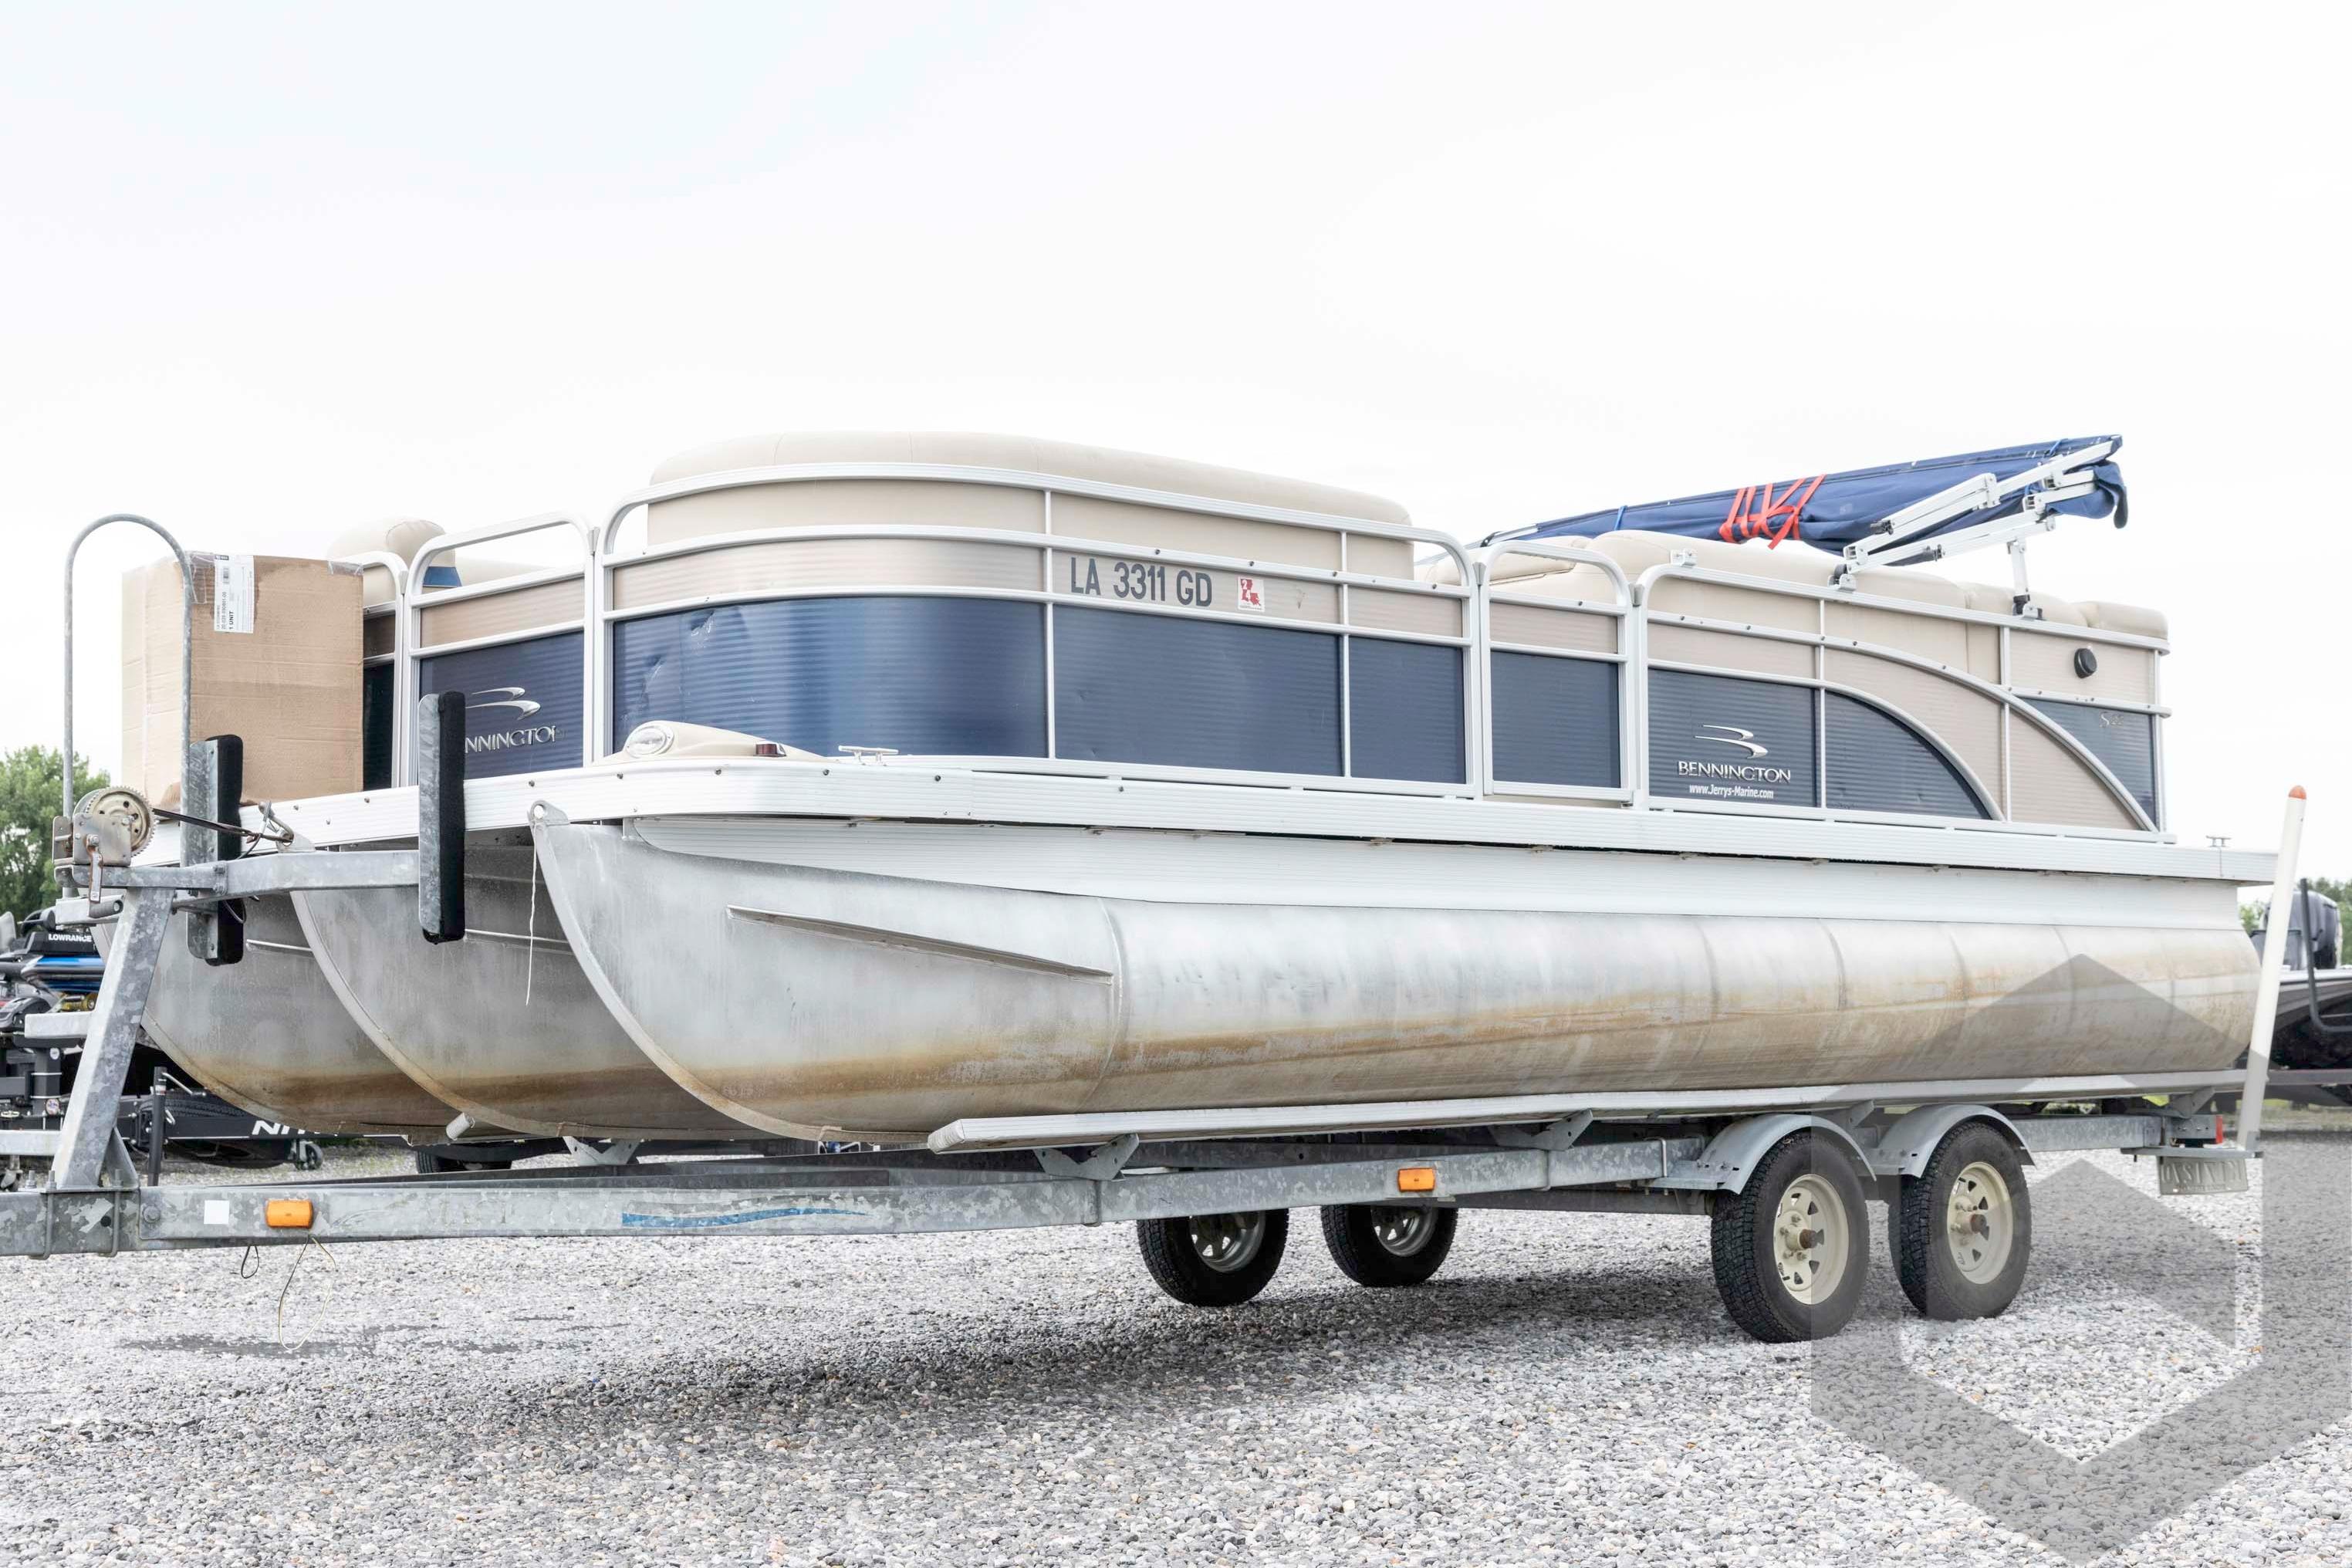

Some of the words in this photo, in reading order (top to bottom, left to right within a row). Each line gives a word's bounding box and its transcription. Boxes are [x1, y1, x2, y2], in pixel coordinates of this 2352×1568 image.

[1070, 557, 1101, 596] LA
[1113, 561, 1166, 602] 3311
[1176, 569, 1212, 607] GD
[1678, 761, 1791, 783] BENNINGTON
[1688, 784, 1774, 799] www.Jerrys-Marine.com
[48, 930, 92, 942] LOWRANCE
